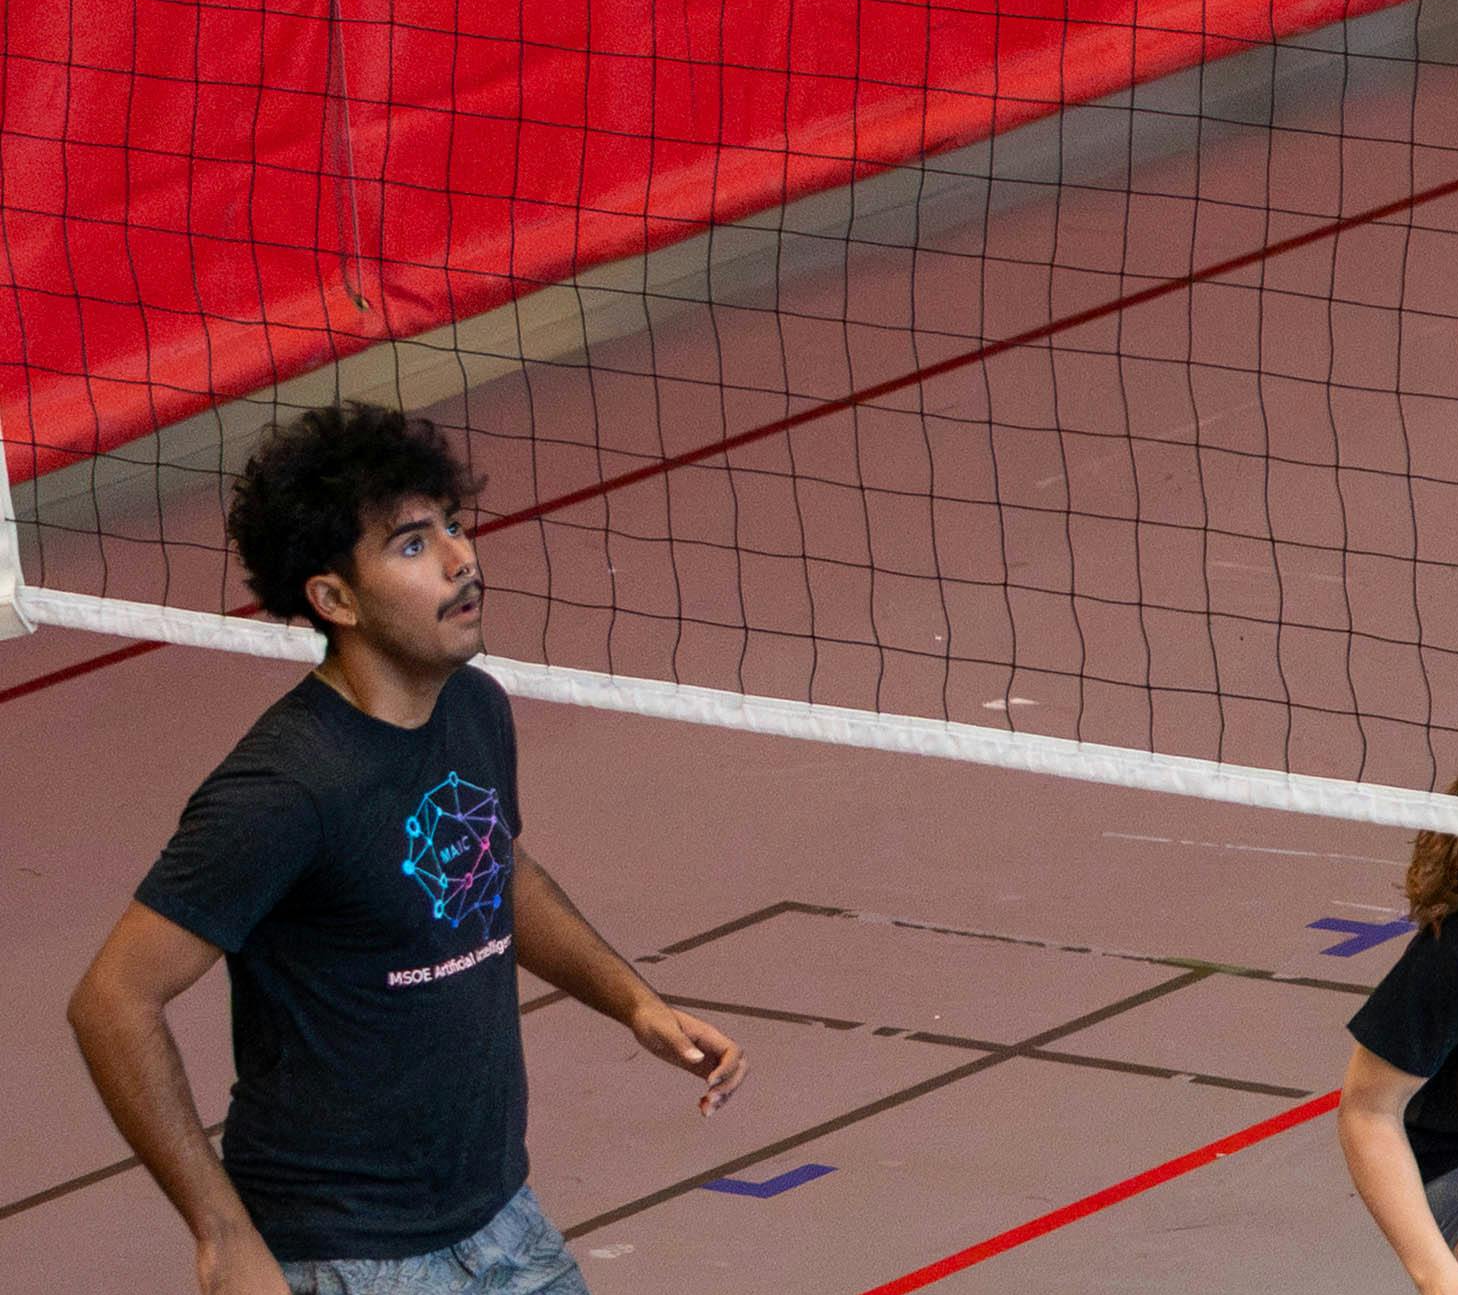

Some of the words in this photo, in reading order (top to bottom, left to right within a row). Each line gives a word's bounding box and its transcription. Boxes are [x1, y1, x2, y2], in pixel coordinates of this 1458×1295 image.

[440, 835, 471, 864] MAIC
[388, 968, 433, 985] MSOE
[434, 952, 476, 978] Artificial
